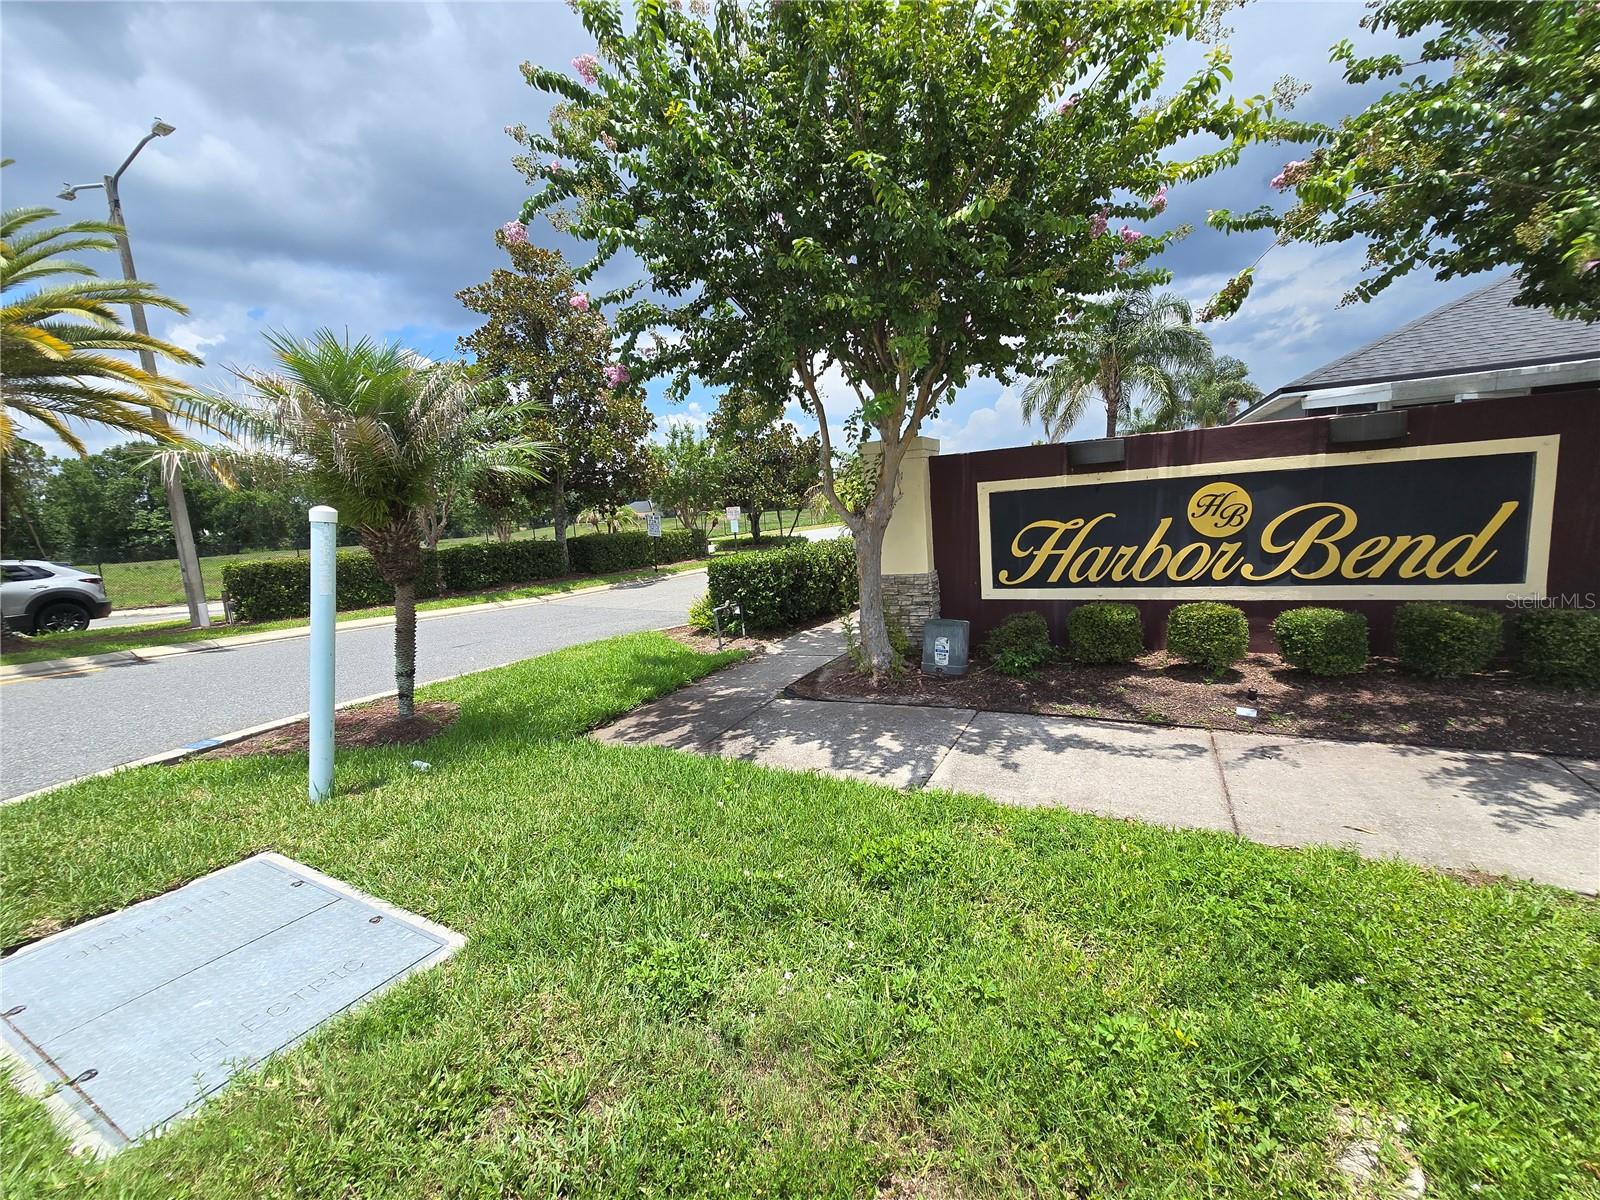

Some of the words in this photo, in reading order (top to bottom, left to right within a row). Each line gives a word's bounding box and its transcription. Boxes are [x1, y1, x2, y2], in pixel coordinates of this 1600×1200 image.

[999, 513, 1244, 585] Harbor
[1241, 502, 1519, 581] Bend
[1191, 490, 1248, 528] HB
[190, 959, 366, 1062] ELECTRIC
